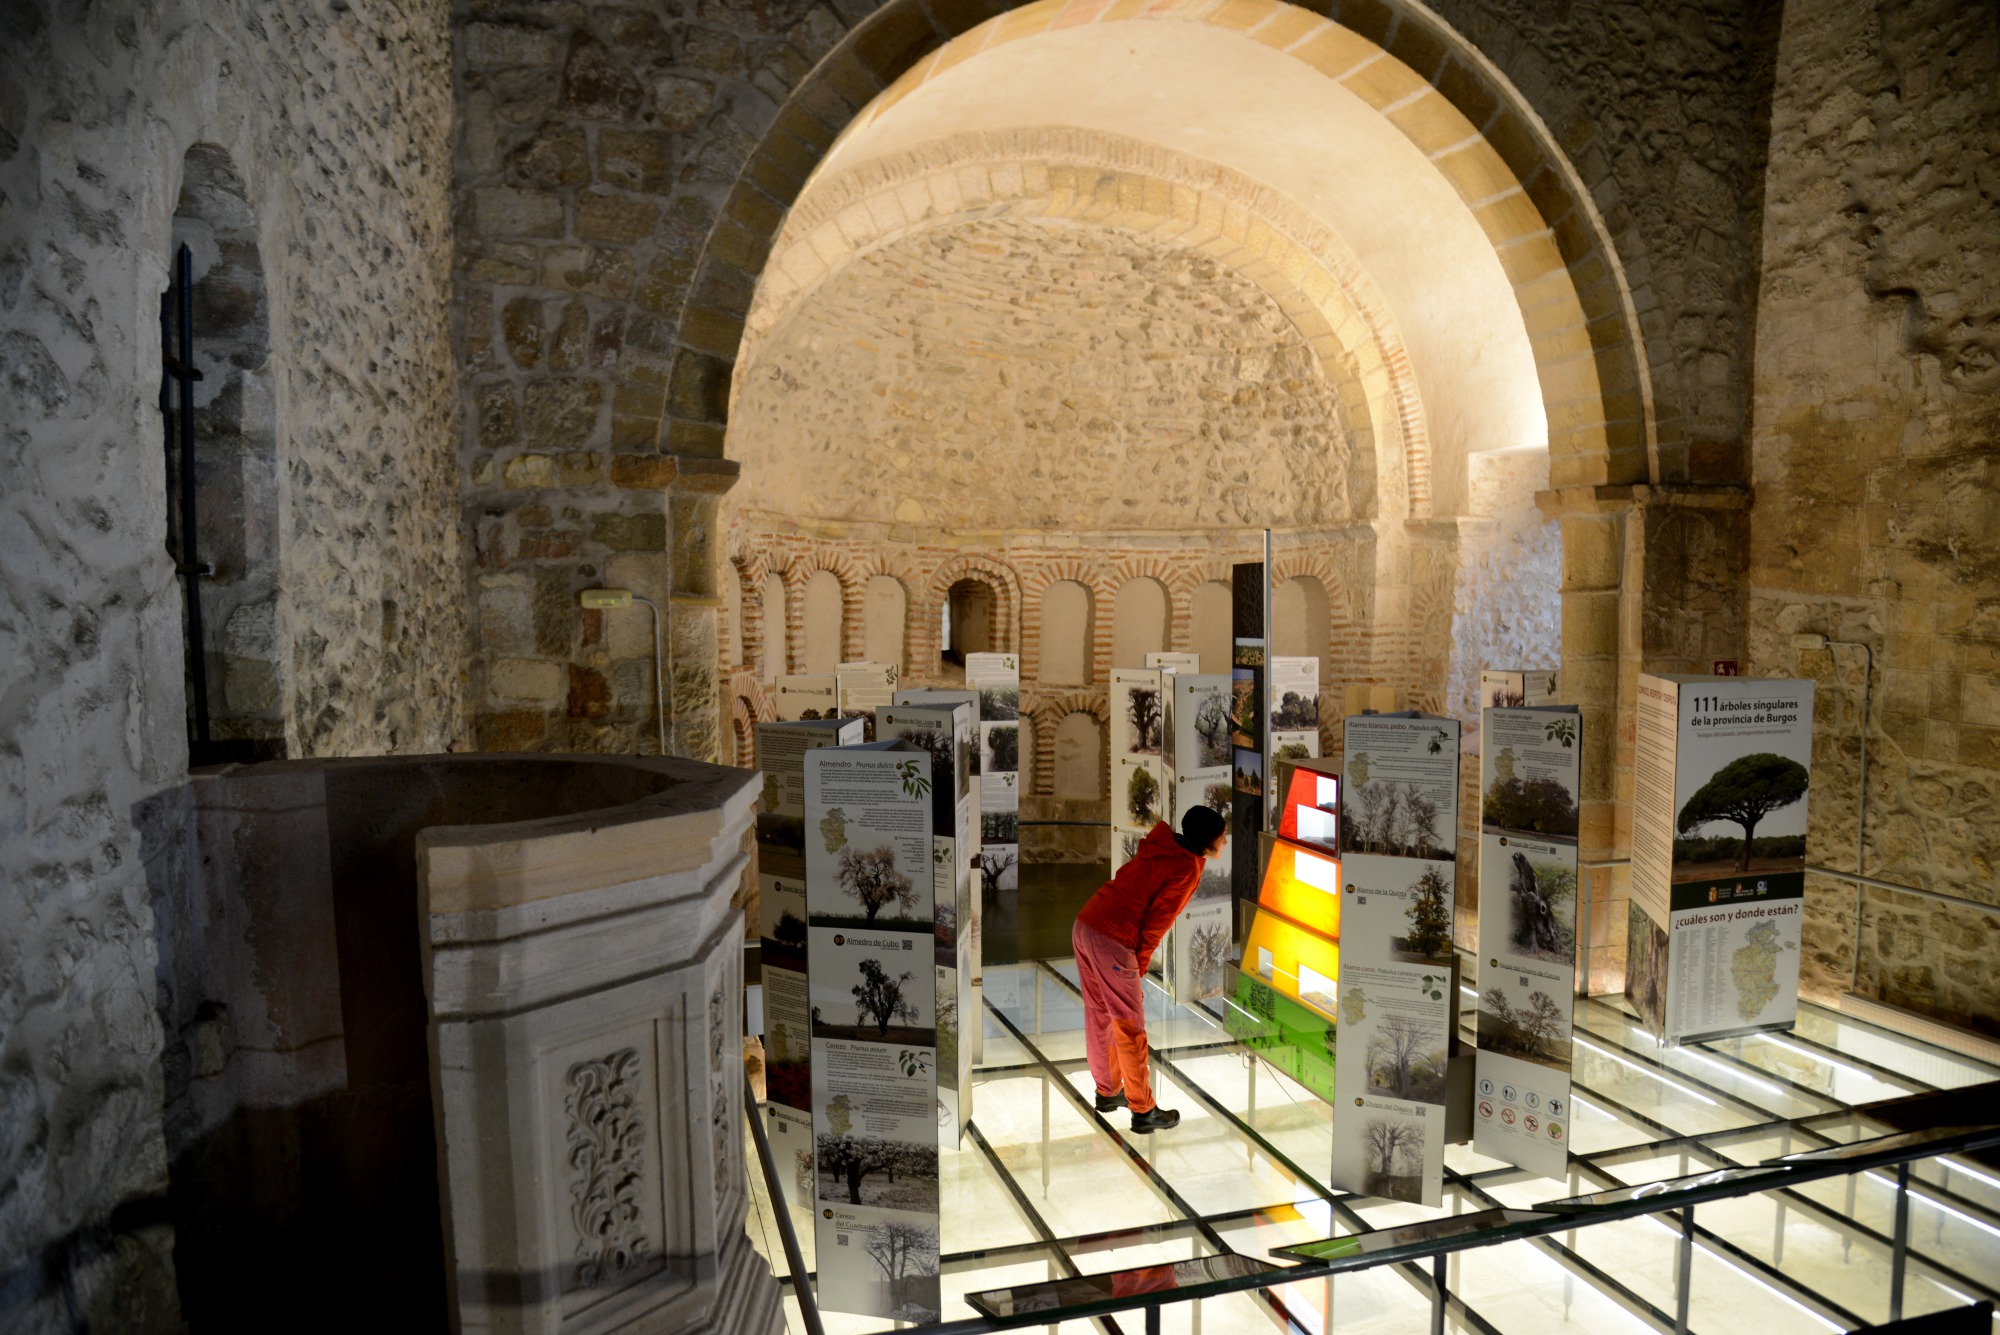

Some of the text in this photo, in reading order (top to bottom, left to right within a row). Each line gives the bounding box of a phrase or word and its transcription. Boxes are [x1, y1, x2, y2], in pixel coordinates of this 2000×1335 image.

[1694, 697, 1799, 712] 111 árboles singulares
[1691, 713, 1798, 727] de la provincia de Burgos
[1391, 723, 1407, 731] pobo
[819, 761, 851, 769] Almendro
[1675, 904, 1799, 929] ¿cuáles son y donde están?
[835, 936, 844, 944] 97
[873, 938, 881, 946] de
[882, 940, 899, 948] Cubo
[826, 1042, 846, 1050] Cerezo
[851, 1044, 869, 1052] Prunus
[824, 1210, 855, 1220] 98 Cerezo
